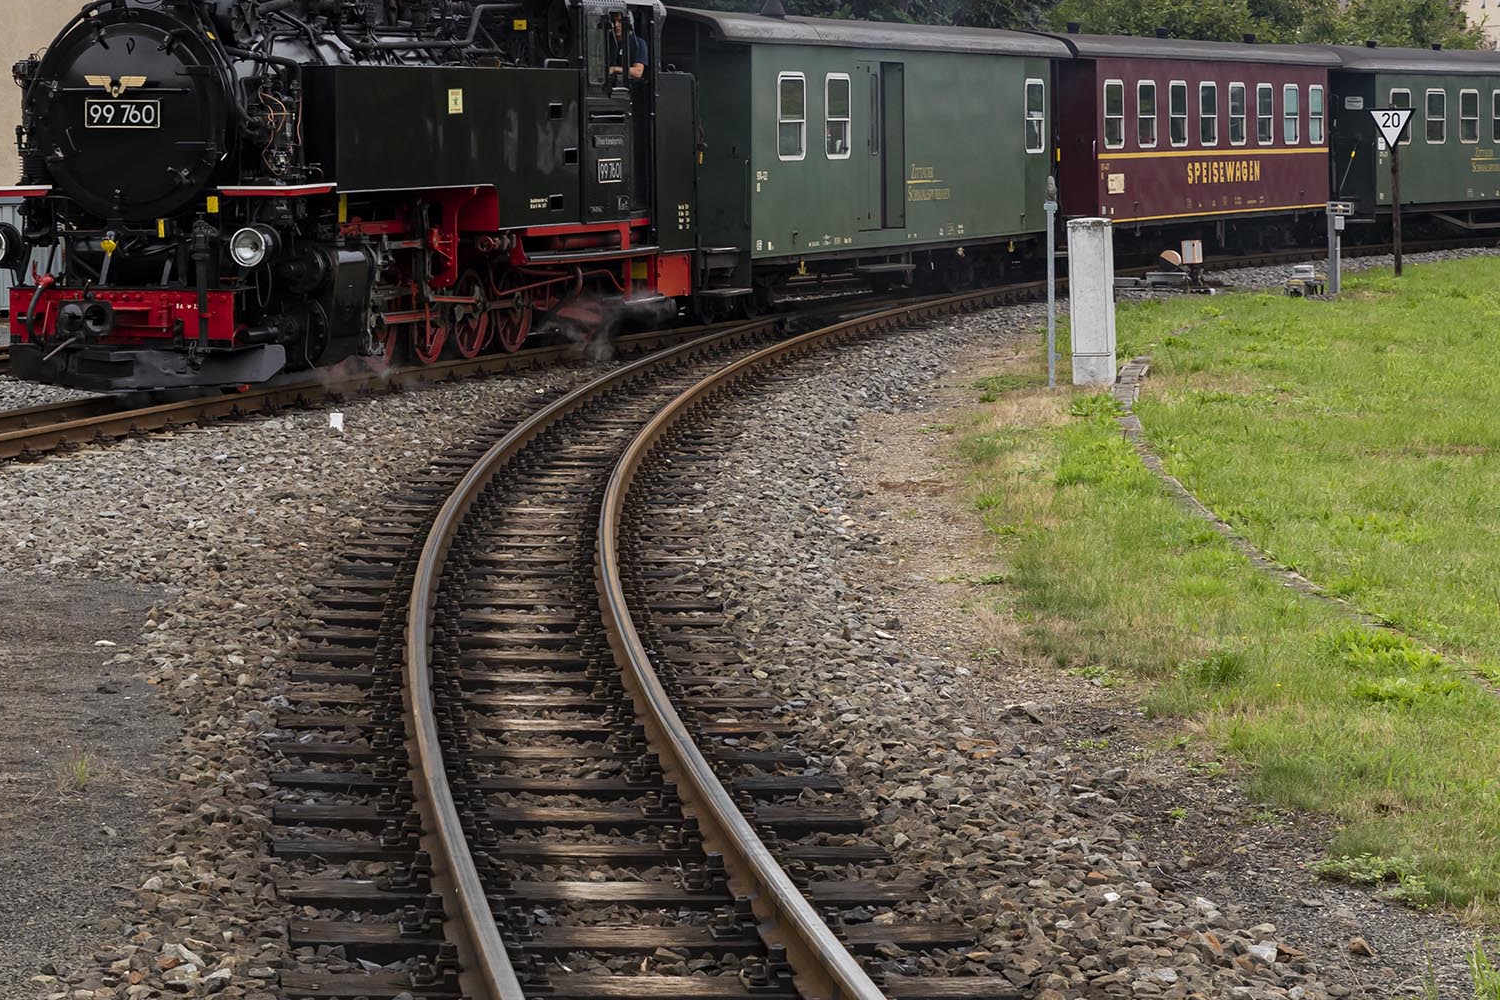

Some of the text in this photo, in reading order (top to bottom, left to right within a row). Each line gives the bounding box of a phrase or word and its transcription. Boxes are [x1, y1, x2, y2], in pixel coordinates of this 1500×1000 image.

[89, 104, 155, 124] 99 760
[1381, 112, 1401, 128] 20
[600, 162, 620, 180] 99 760
[1187, 160, 1260, 185] SPEISEWAGEN
